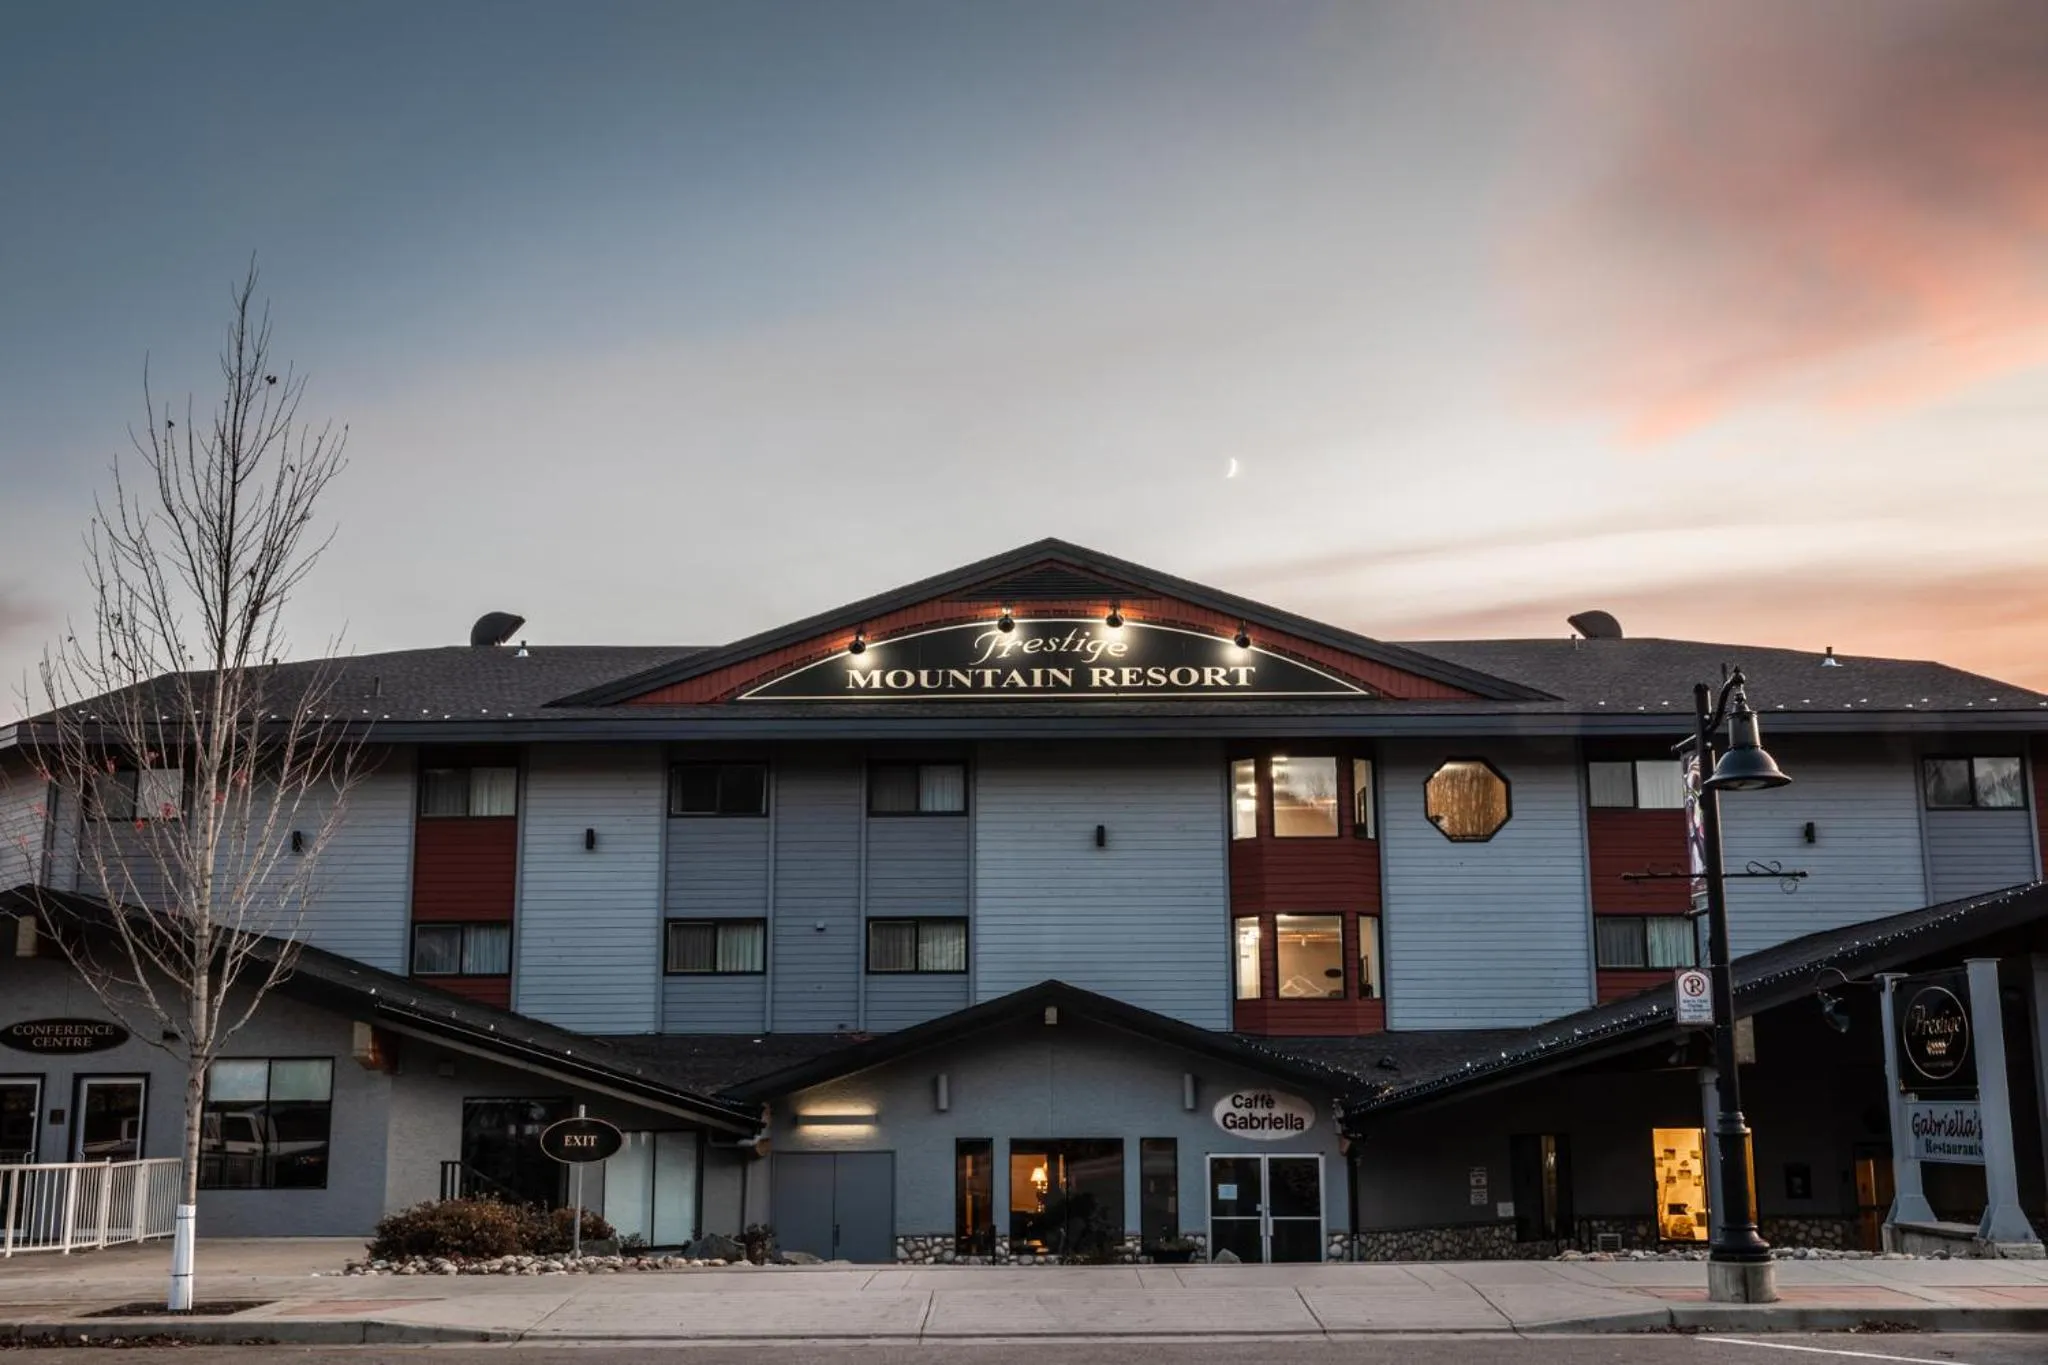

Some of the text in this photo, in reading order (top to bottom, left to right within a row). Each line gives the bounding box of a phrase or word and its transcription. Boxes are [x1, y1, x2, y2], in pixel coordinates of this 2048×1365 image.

[968, 627, 1129, 666] Prestige
[846, 666, 1257, 689] MOUNTAIN RESORT
[12, 1024, 114, 1036] CONFERENCE
[32, 1036, 93, 1048] CENTRE
[1221, 1111, 1305, 1131] Gabriella
[563, 1134, 598, 1147] EXIT
